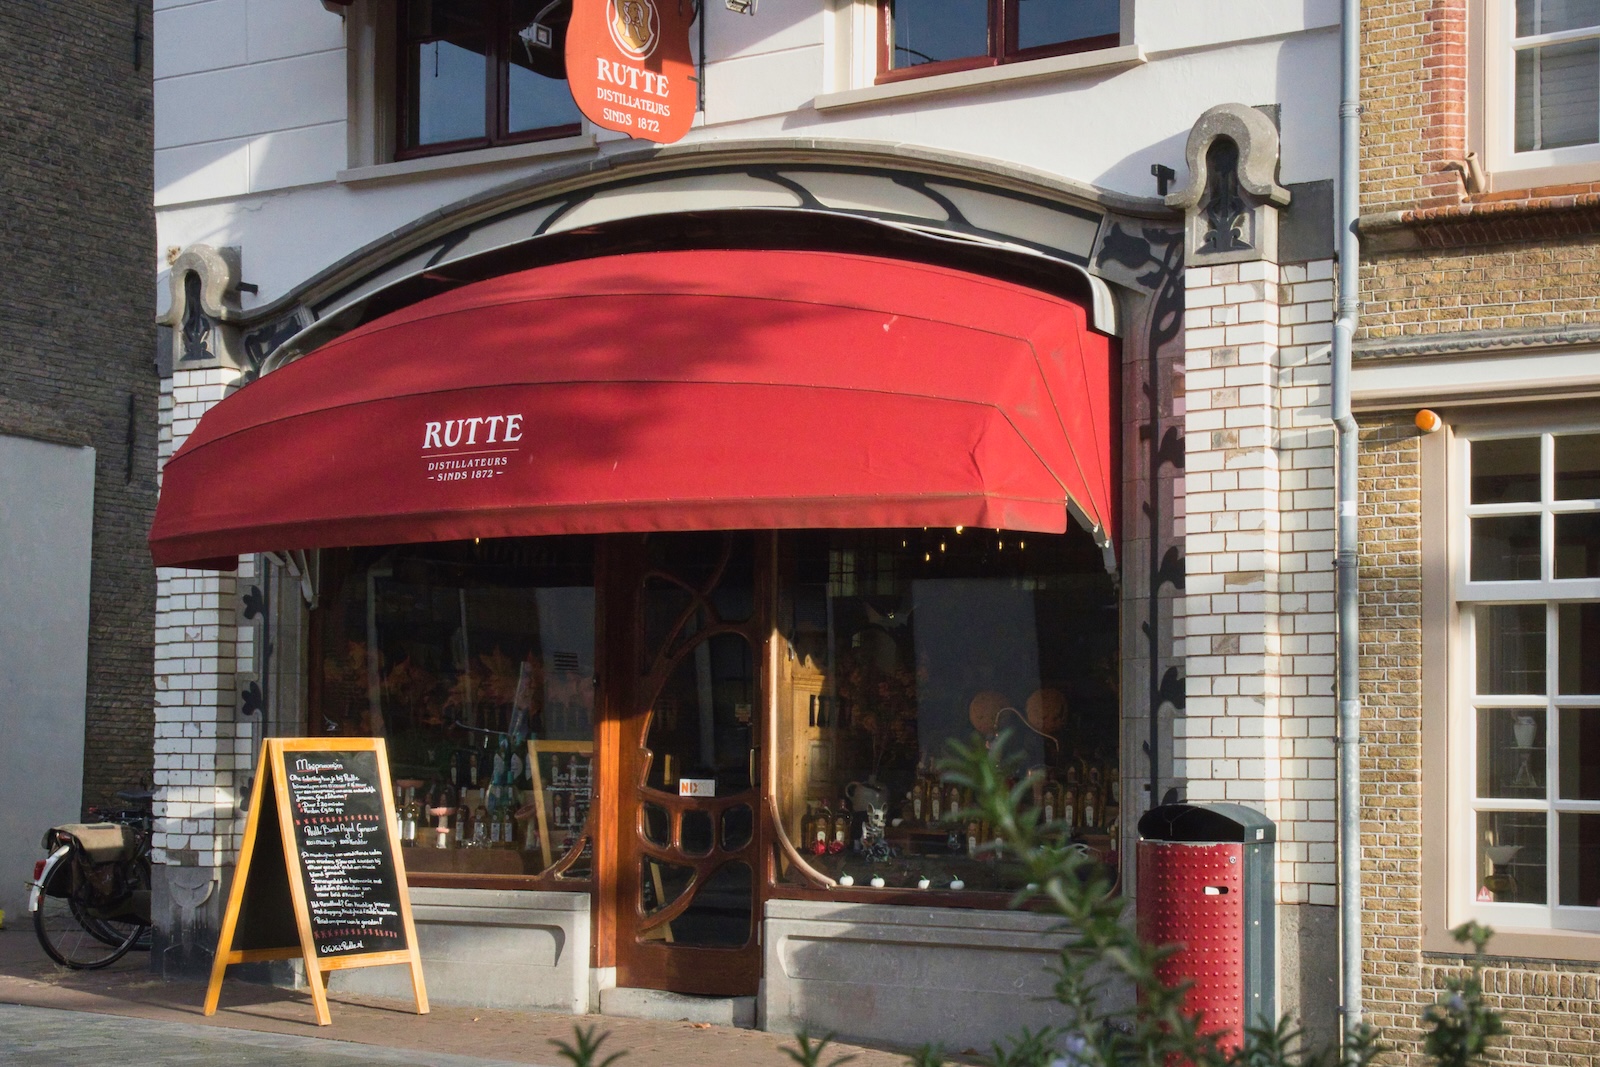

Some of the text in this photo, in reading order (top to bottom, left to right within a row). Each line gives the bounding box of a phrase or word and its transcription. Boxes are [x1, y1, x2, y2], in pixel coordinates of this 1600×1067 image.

[596, 57, 670, 98] RUTTE
[596, 86, 671, 117] DISTILLATEURS
[603, 108, 660, 132] SINDS 1872
[422, 413, 523, 449] RUTTE
[427, 456, 508, 471] DISTILLATEURS
[437, 469, 494, 482] SINDS 1872
